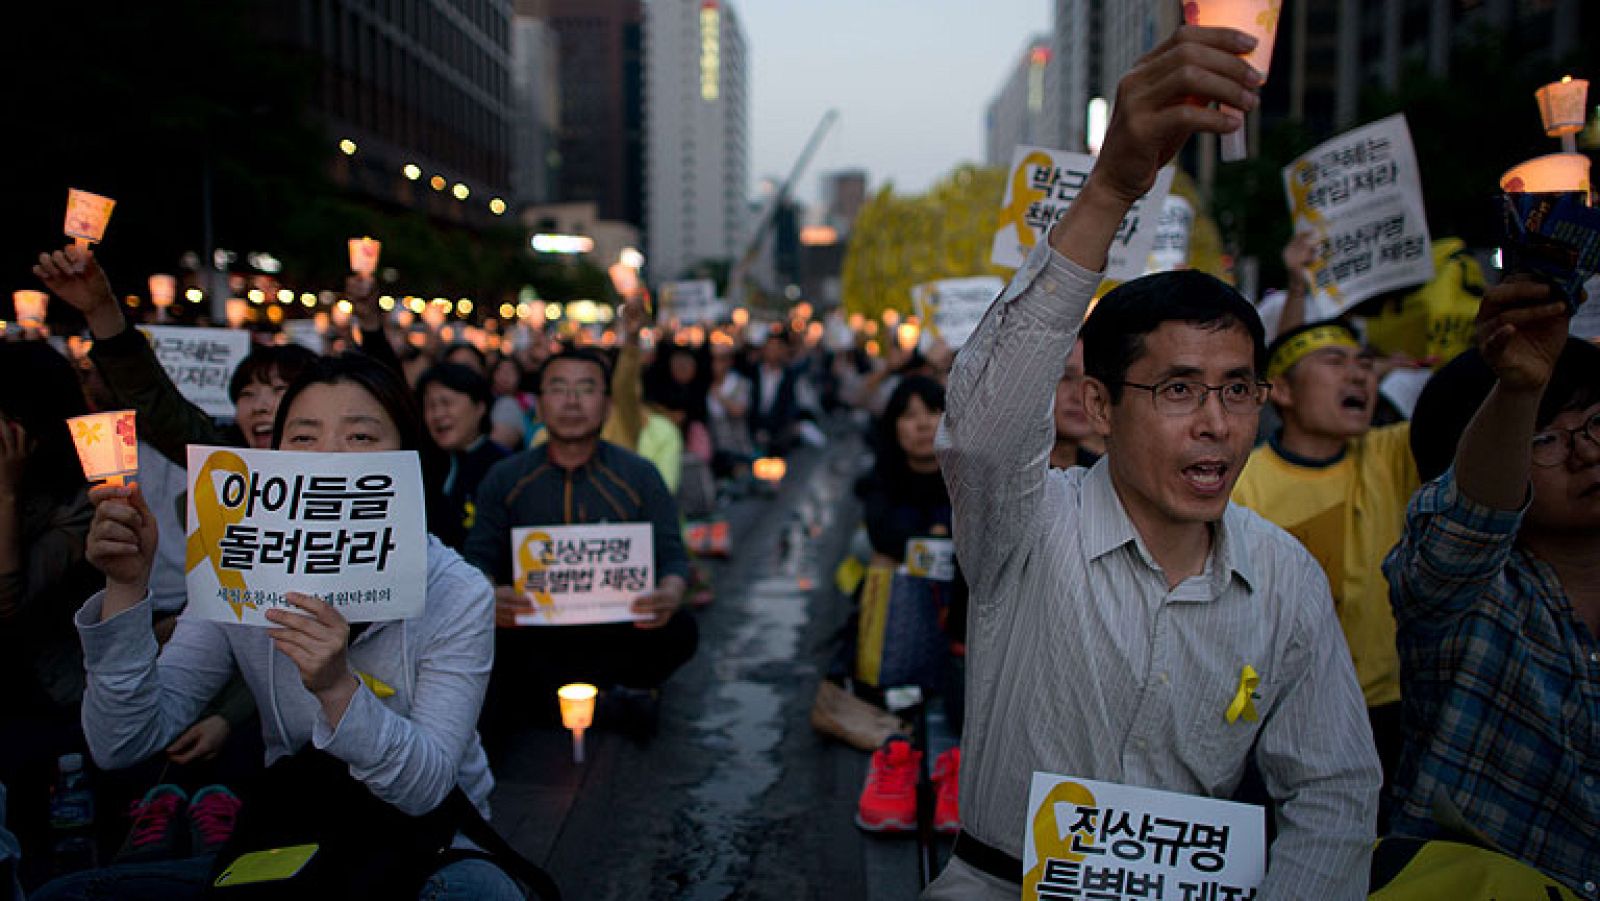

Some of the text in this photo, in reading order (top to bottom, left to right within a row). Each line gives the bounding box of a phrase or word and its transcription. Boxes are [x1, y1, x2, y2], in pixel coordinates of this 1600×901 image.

[222, 471, 395, 520] 아이들을
[220, 525, 396, 575] 돌려달라
[541, 537, 631, 565] 진상규명
[525, 564, 648, 593] 특별법 제정
[1069, 806, 1230, 872] 진상규명
[1037, 858, 1164, 901] 특별법
